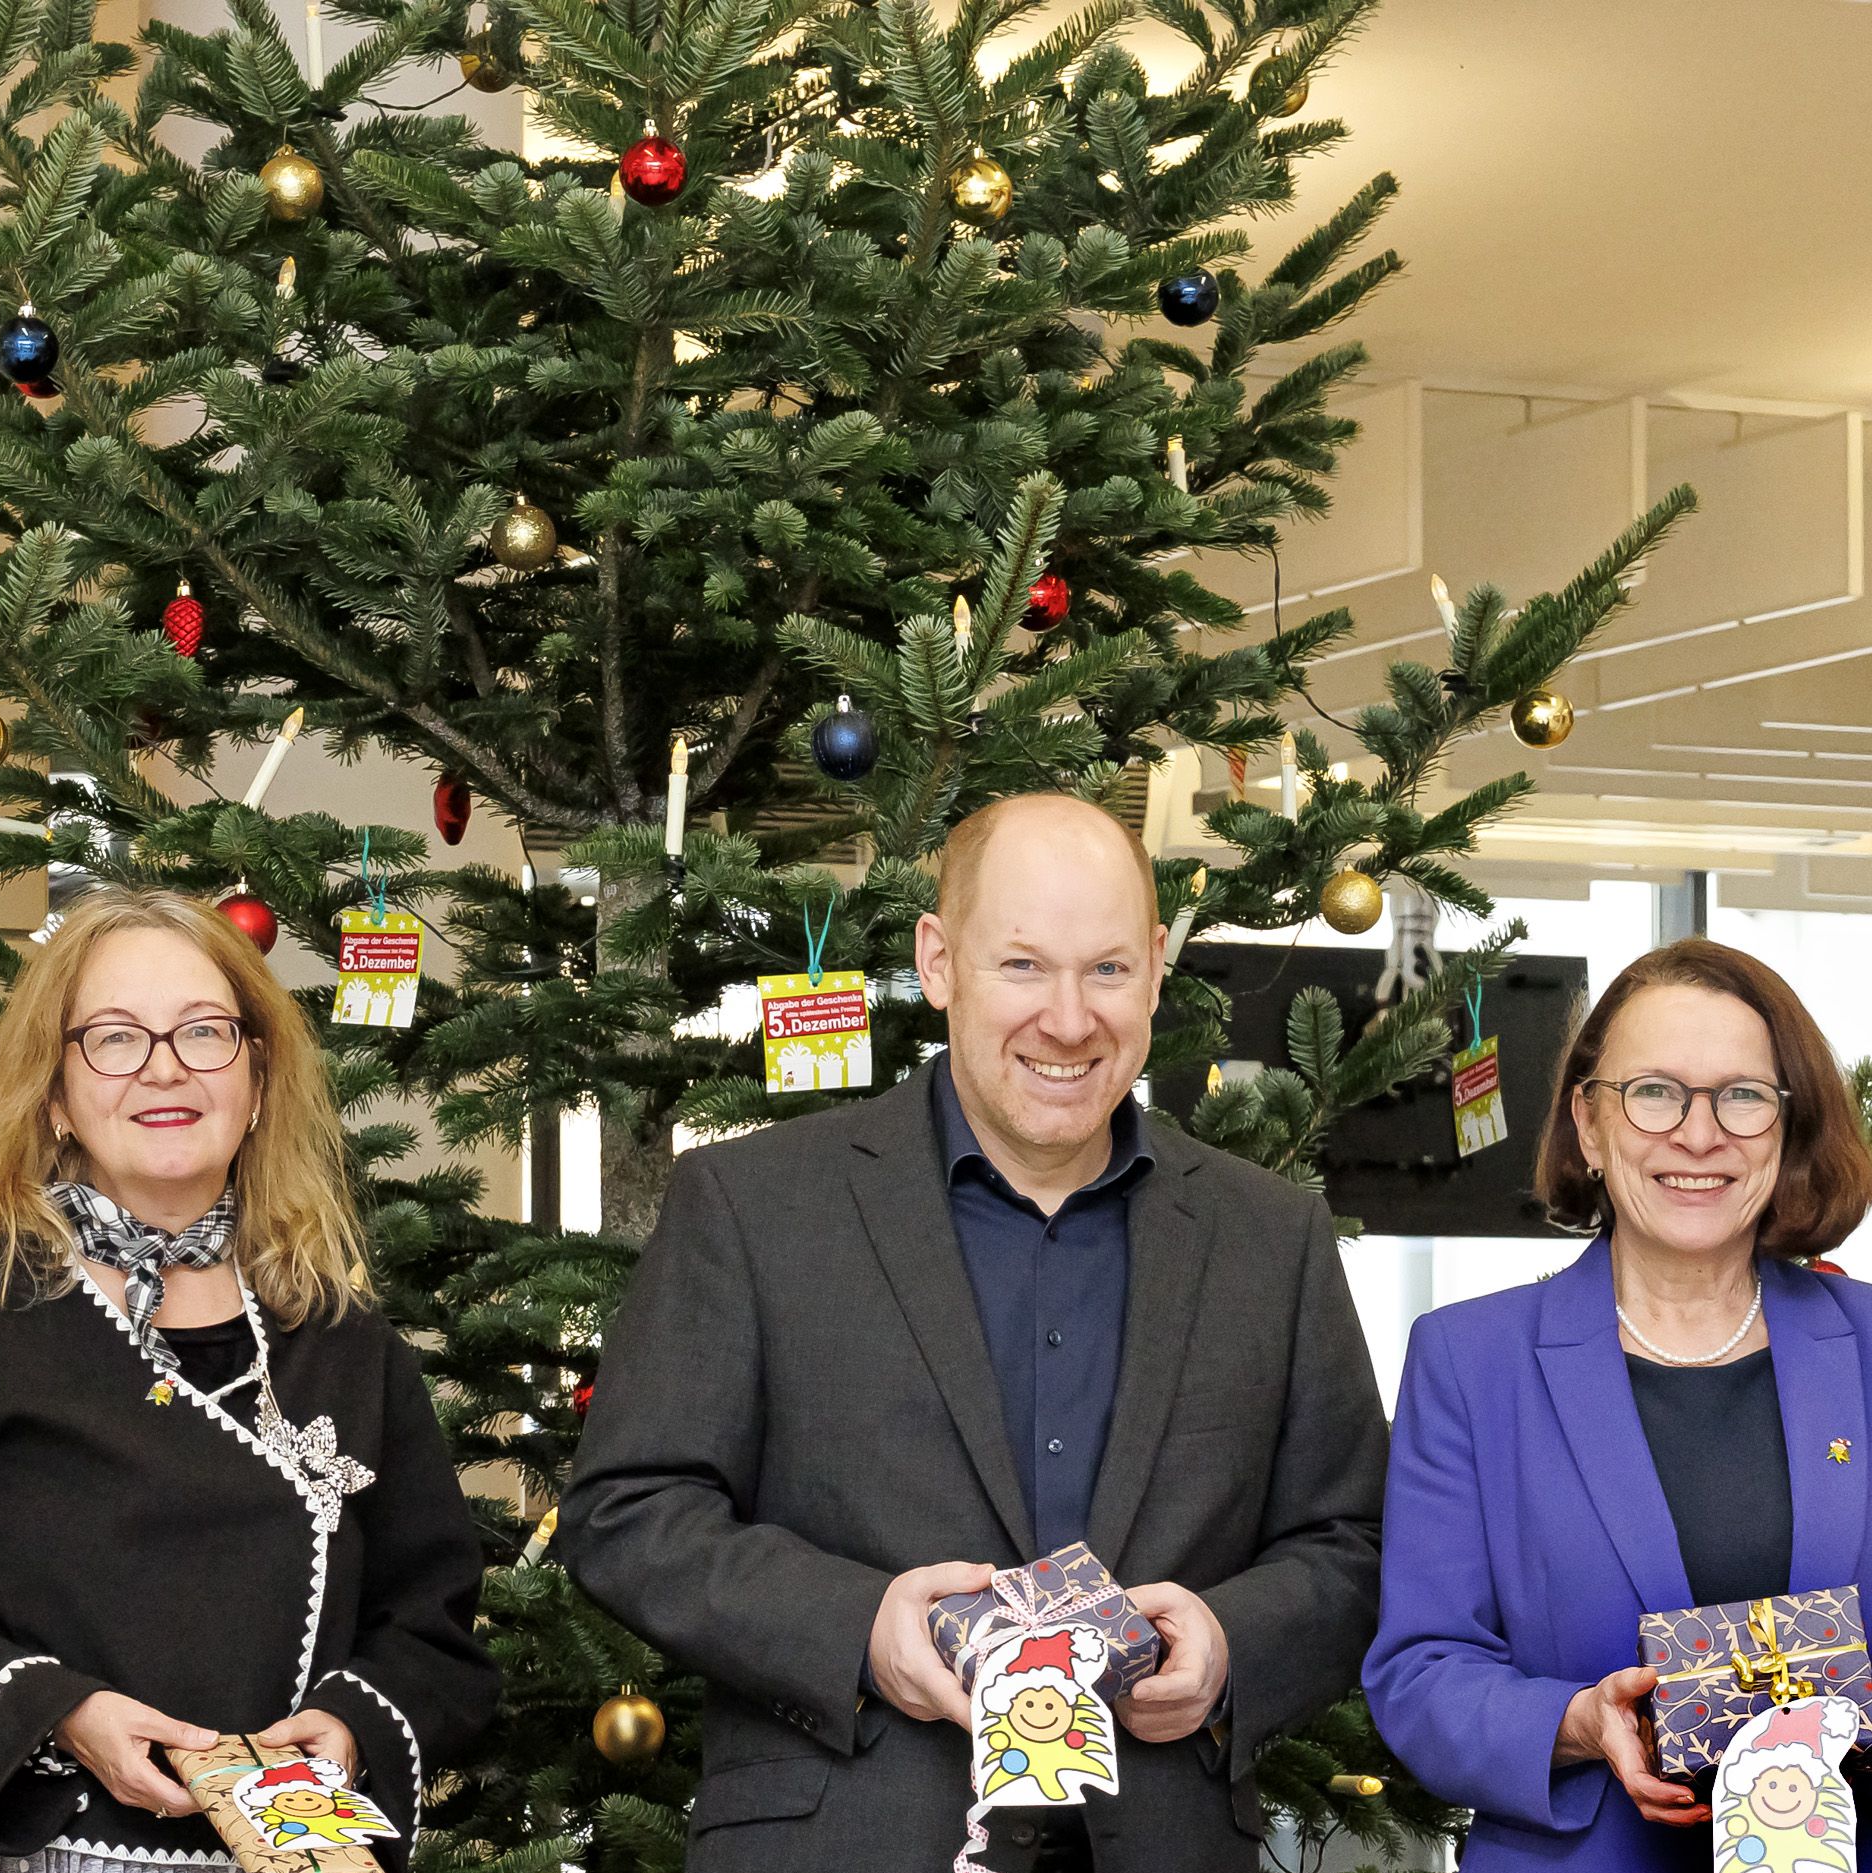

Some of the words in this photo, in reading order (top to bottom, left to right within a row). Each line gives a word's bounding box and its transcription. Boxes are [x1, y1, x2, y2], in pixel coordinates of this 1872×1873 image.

[359, 955, 417, 969] Dezember
[767, 1001, 800, 1012] Abgabe
[801, 998, 815, 1007] der
[816, 993, 863, 1006] Geschenke
[791, 1014, 866, 1033] Dezember
